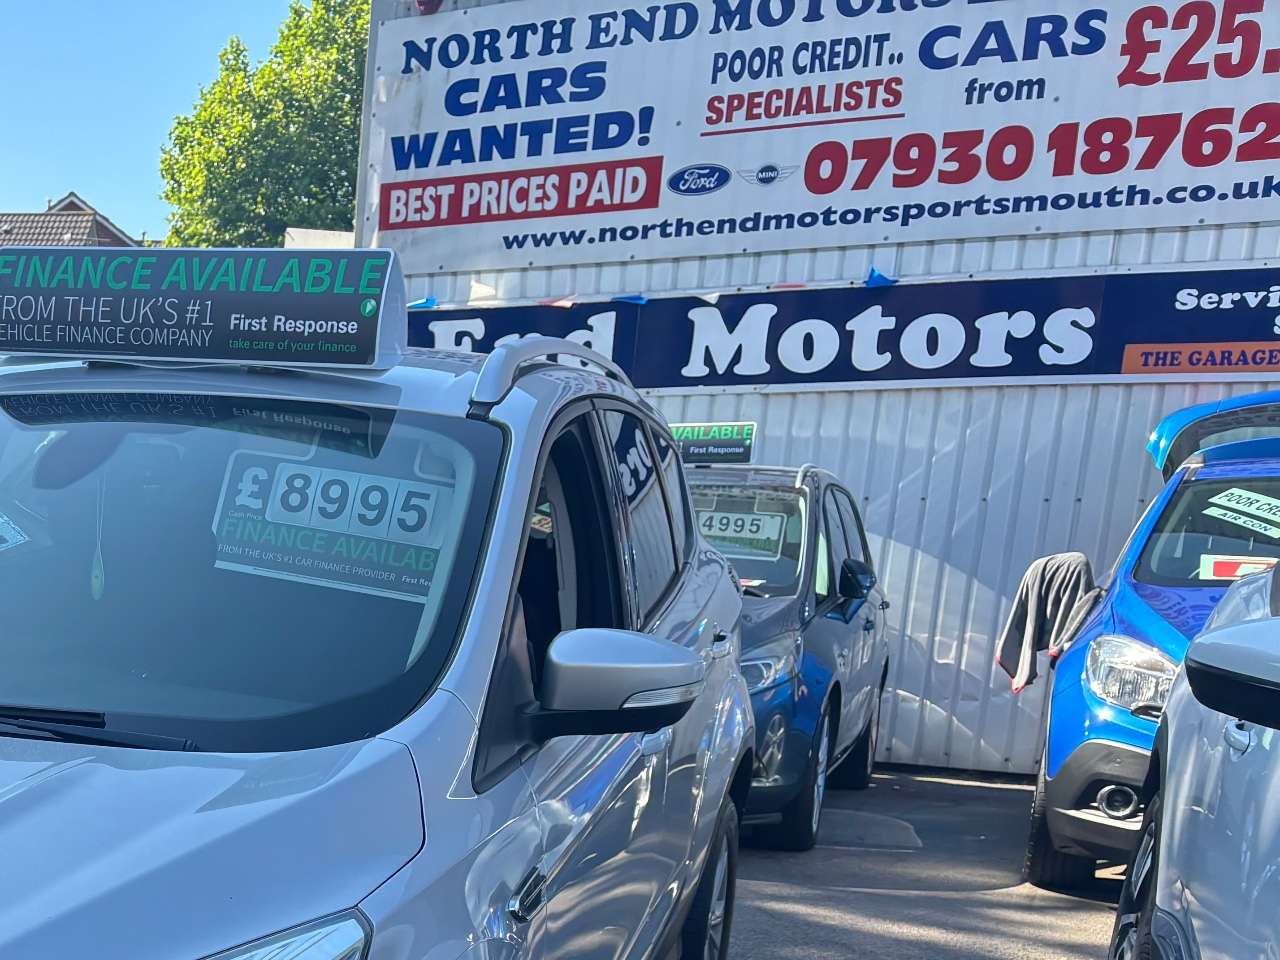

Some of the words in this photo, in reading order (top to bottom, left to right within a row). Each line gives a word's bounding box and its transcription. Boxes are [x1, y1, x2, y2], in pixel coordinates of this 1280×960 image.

[401, 17, 577, 75] NORTH
[586, 1, 699, 50] END
[919, 8, 1109, 70] CARS
[710, 45, 785, 84] POOR
[443, 61, 607, 117] CARS
[705, 77, 904, 125] SPECIALISTS
[965, 77, 1047, 105] from
[391, 106, 655, 171] WANTED!
[804, 125, 1035, 195] 07930
[1047, 102, 1280, 177] 18762
[677, 168, 720, 192] Ford
[758, 171, 778, 179] MINI
[389, 183, 456, 225] BEST
[461, 174, 561, 217] PRICES
[568, 166, 648, 209] PAID
[502, 175, 1280, 250] www.northendmotorsportsmouth.co.uk
[160, 256, 388, 296] AVAILABLE
[63, 296, 114, 324] THE
[120, 297, 179, 326] UK'S
[185, 299, 215, 327] #1
[230, 313, 268, 331] First
[273, 314, 358, 336] Response
[57, 325, 126, 346] FINANCE
[130, 328, 214, 349] COMPANY
[229, 338, 250, 349] take
[252, 340, 275, 350] care
[277, 339, 289, 350] of
[290, 342, 315, 353] your
[318, 340, 357, 353] finance
[681, 303, 1097, 379] Motors
[1140, 351, 1182, 367] THE
[1188, 348, 1280, 367] GARAGE
[689, 445, 707, 454] First
[1218, 491, 1256, 509] POOR
[221, 518, 327, 552] FINANCE
[702, 515, 762, 535] 4995
[1217, 511, 1241, 521] AIR
[1243, 519, 1272, 532] CON
[243, 548, 261, 559] THE
[295, 557, 313, 569] CAR
[314, 560, 350, 574] FINANCE
[352, 566, 396, 583] PROVIDER
